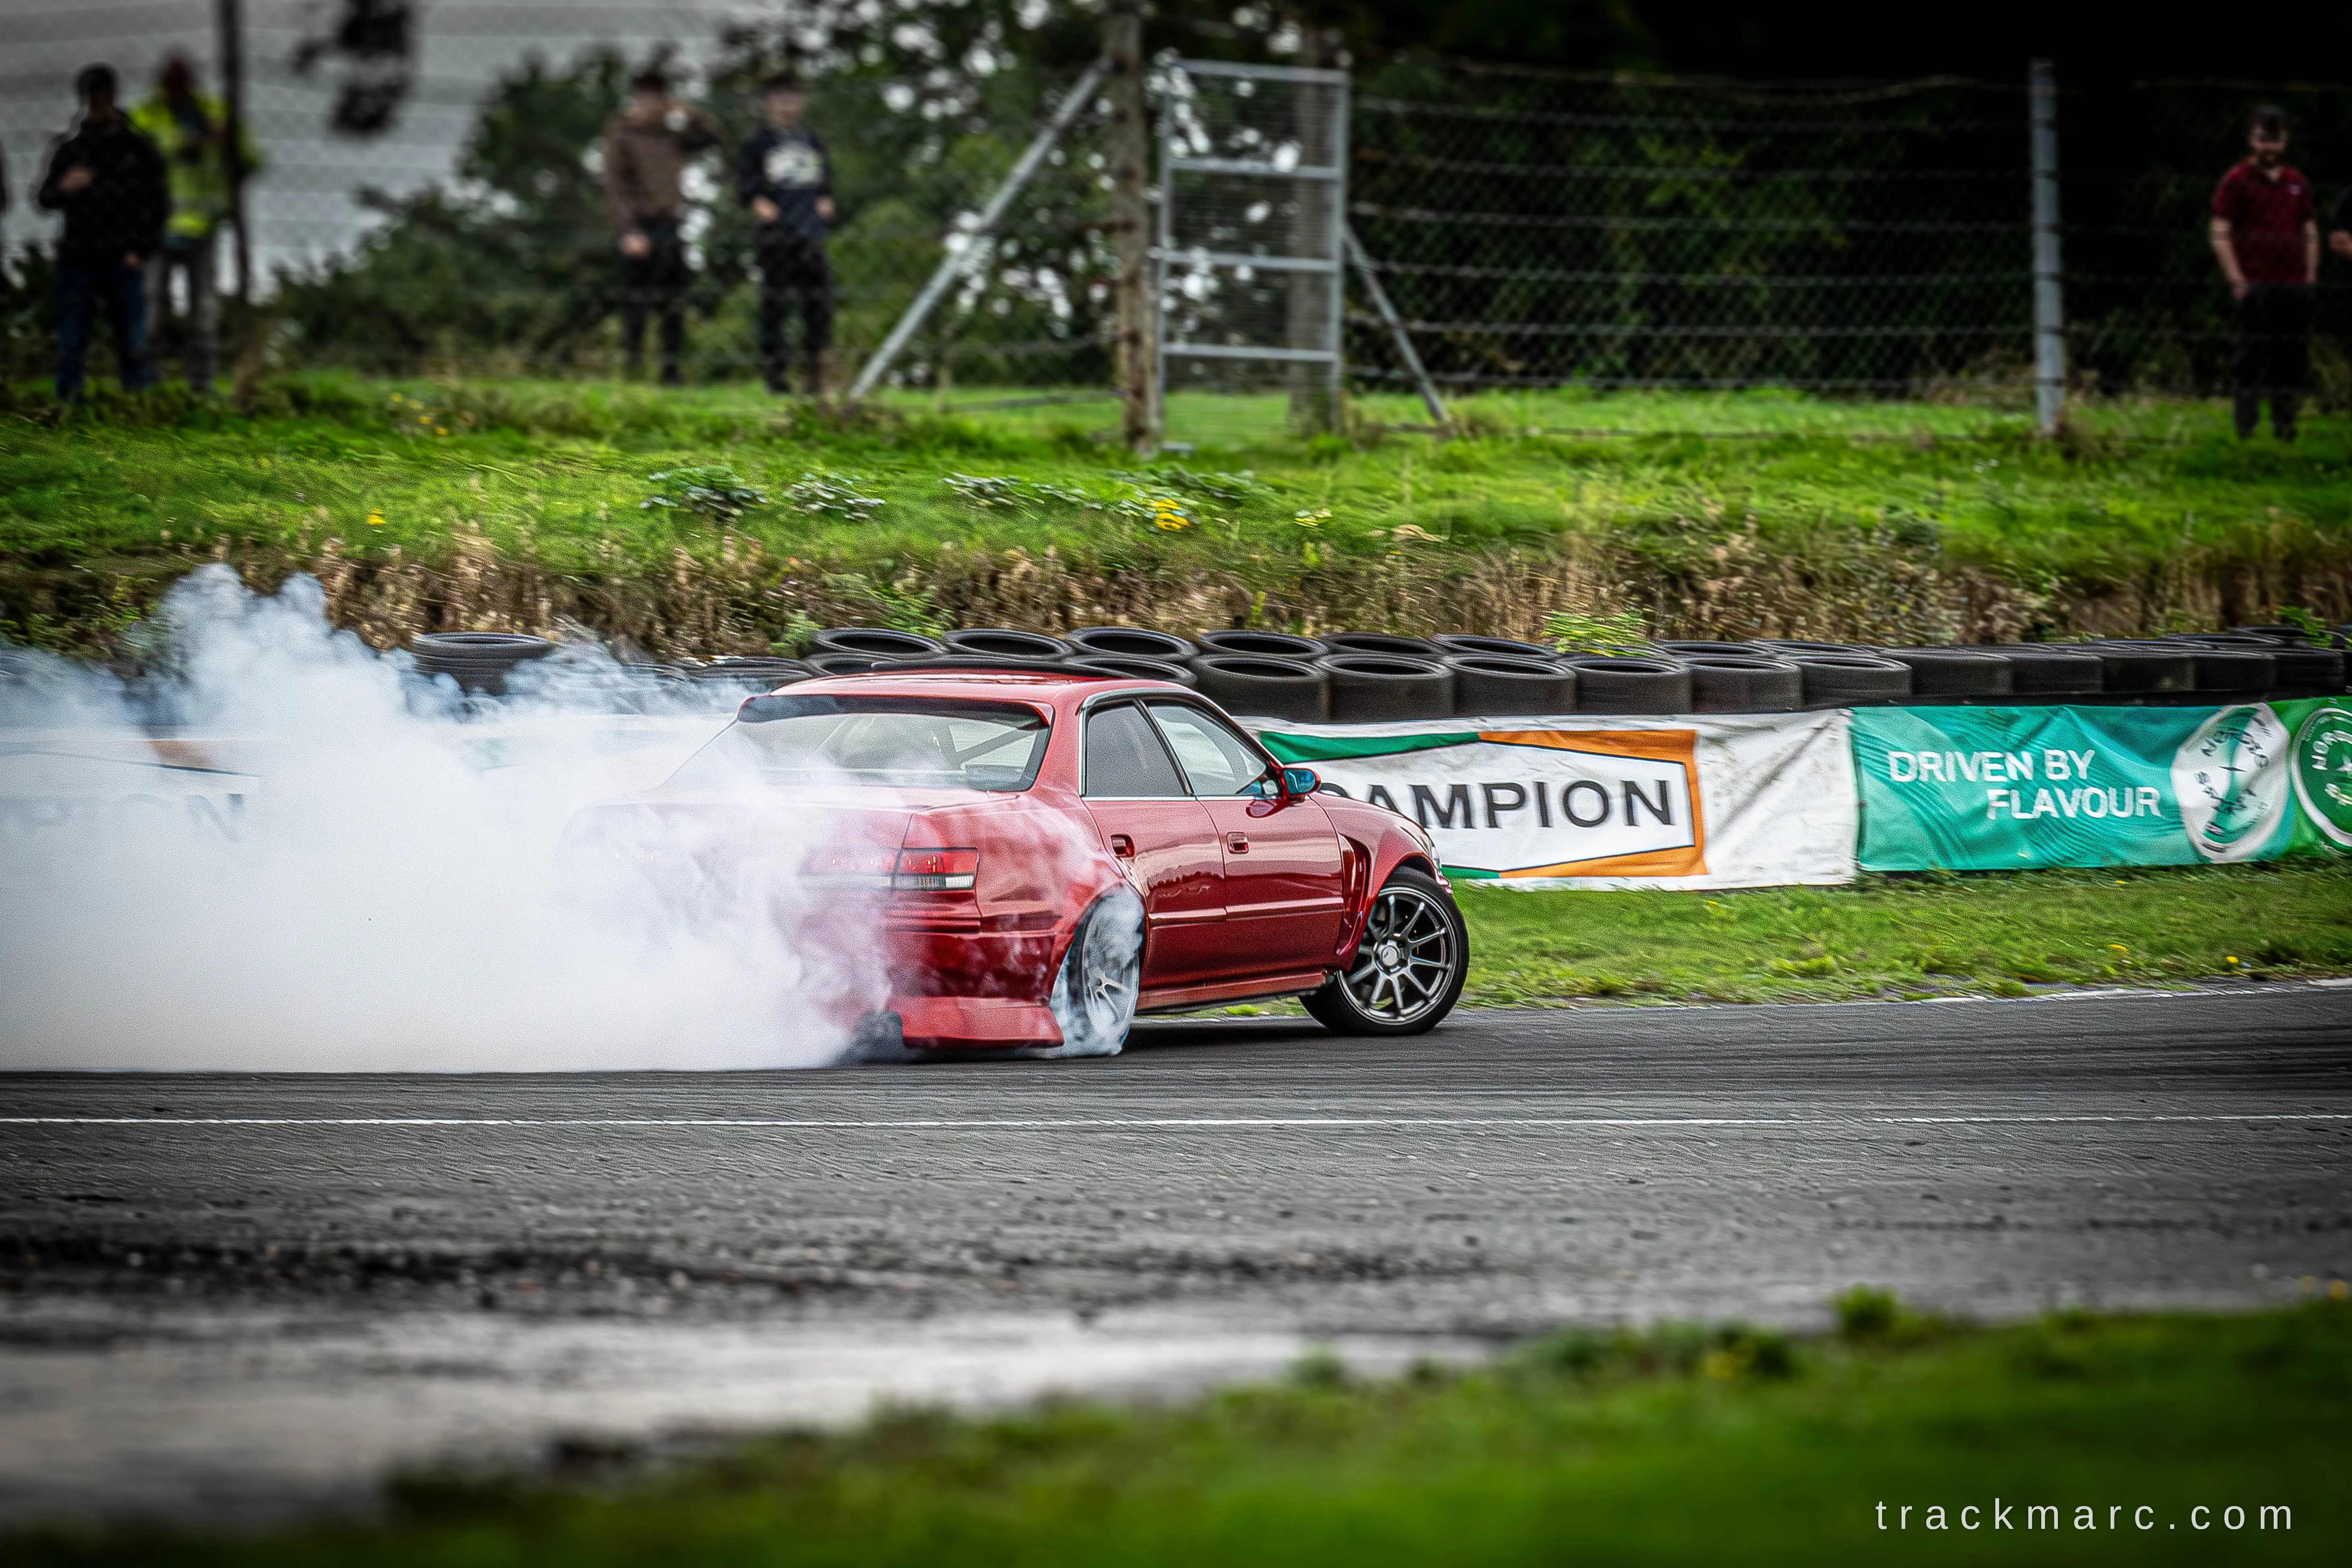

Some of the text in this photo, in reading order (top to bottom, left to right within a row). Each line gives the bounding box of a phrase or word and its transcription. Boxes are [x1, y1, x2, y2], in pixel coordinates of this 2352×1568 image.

[1888, 749, 2095, 782] DRIVEN BY
[1986, 786, 2163, 820] FLAVOUR
